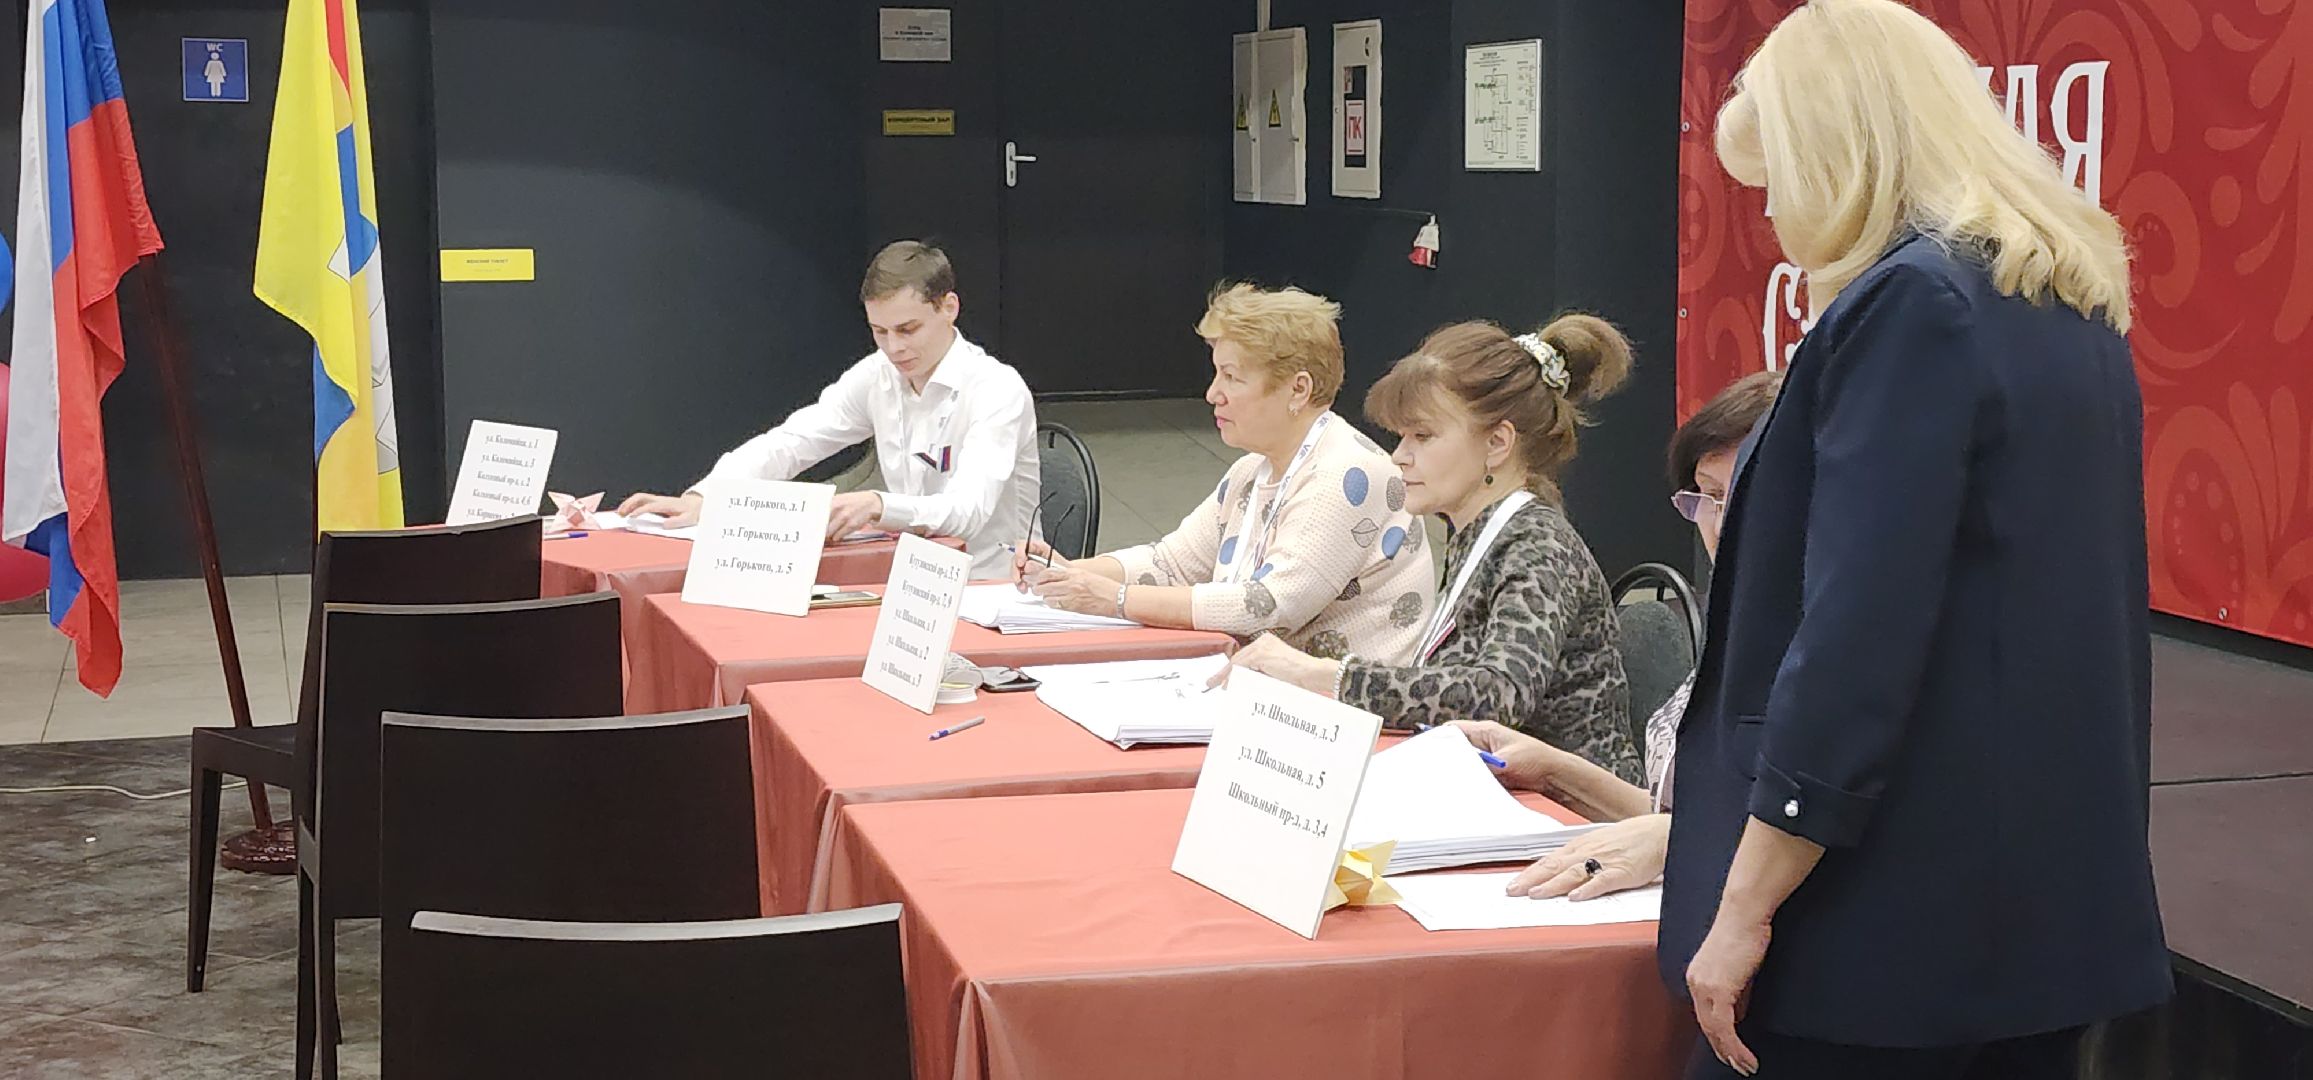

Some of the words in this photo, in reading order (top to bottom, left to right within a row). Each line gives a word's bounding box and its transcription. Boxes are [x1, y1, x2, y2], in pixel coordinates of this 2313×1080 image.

[207, 42, 223, 52] WC
[1349, 116, 1362, 139] ПК
[728, 497, 742, 508] ул.
[744, 496, 787, 511] Горького,
[789, 503, 798, 512] д.
[801, 501, 806, 512] 1
[722, 528, 735, 538] ул.
[737, 527, 781, 542] Горького,
[782, 533, 791, 542] д.
[792, 531, 800, 543] 3
[714, 558, 729, 569] ул.
[730, 557, 774, 573] Горького,
[775, 564, 784, 574] д.
[786, 562, 793, 574] 5
[1251, 701, 1266, 716] ул.
[1268, 703, 1318, 739] Школьная,
[1319, 727, 1328, 741] д.
[1330, 724, 1340, 743] 3
[1238, 745, 1252, 760] ул.
[1255, 748, 1304, 783] Школьная,
[1305, 773, 1314, 786] д.
[1315, 770, 1326, 790] 5
[1228, 781, 1279, 817] Школьный
[1302, 818, 1311, 832] д.
